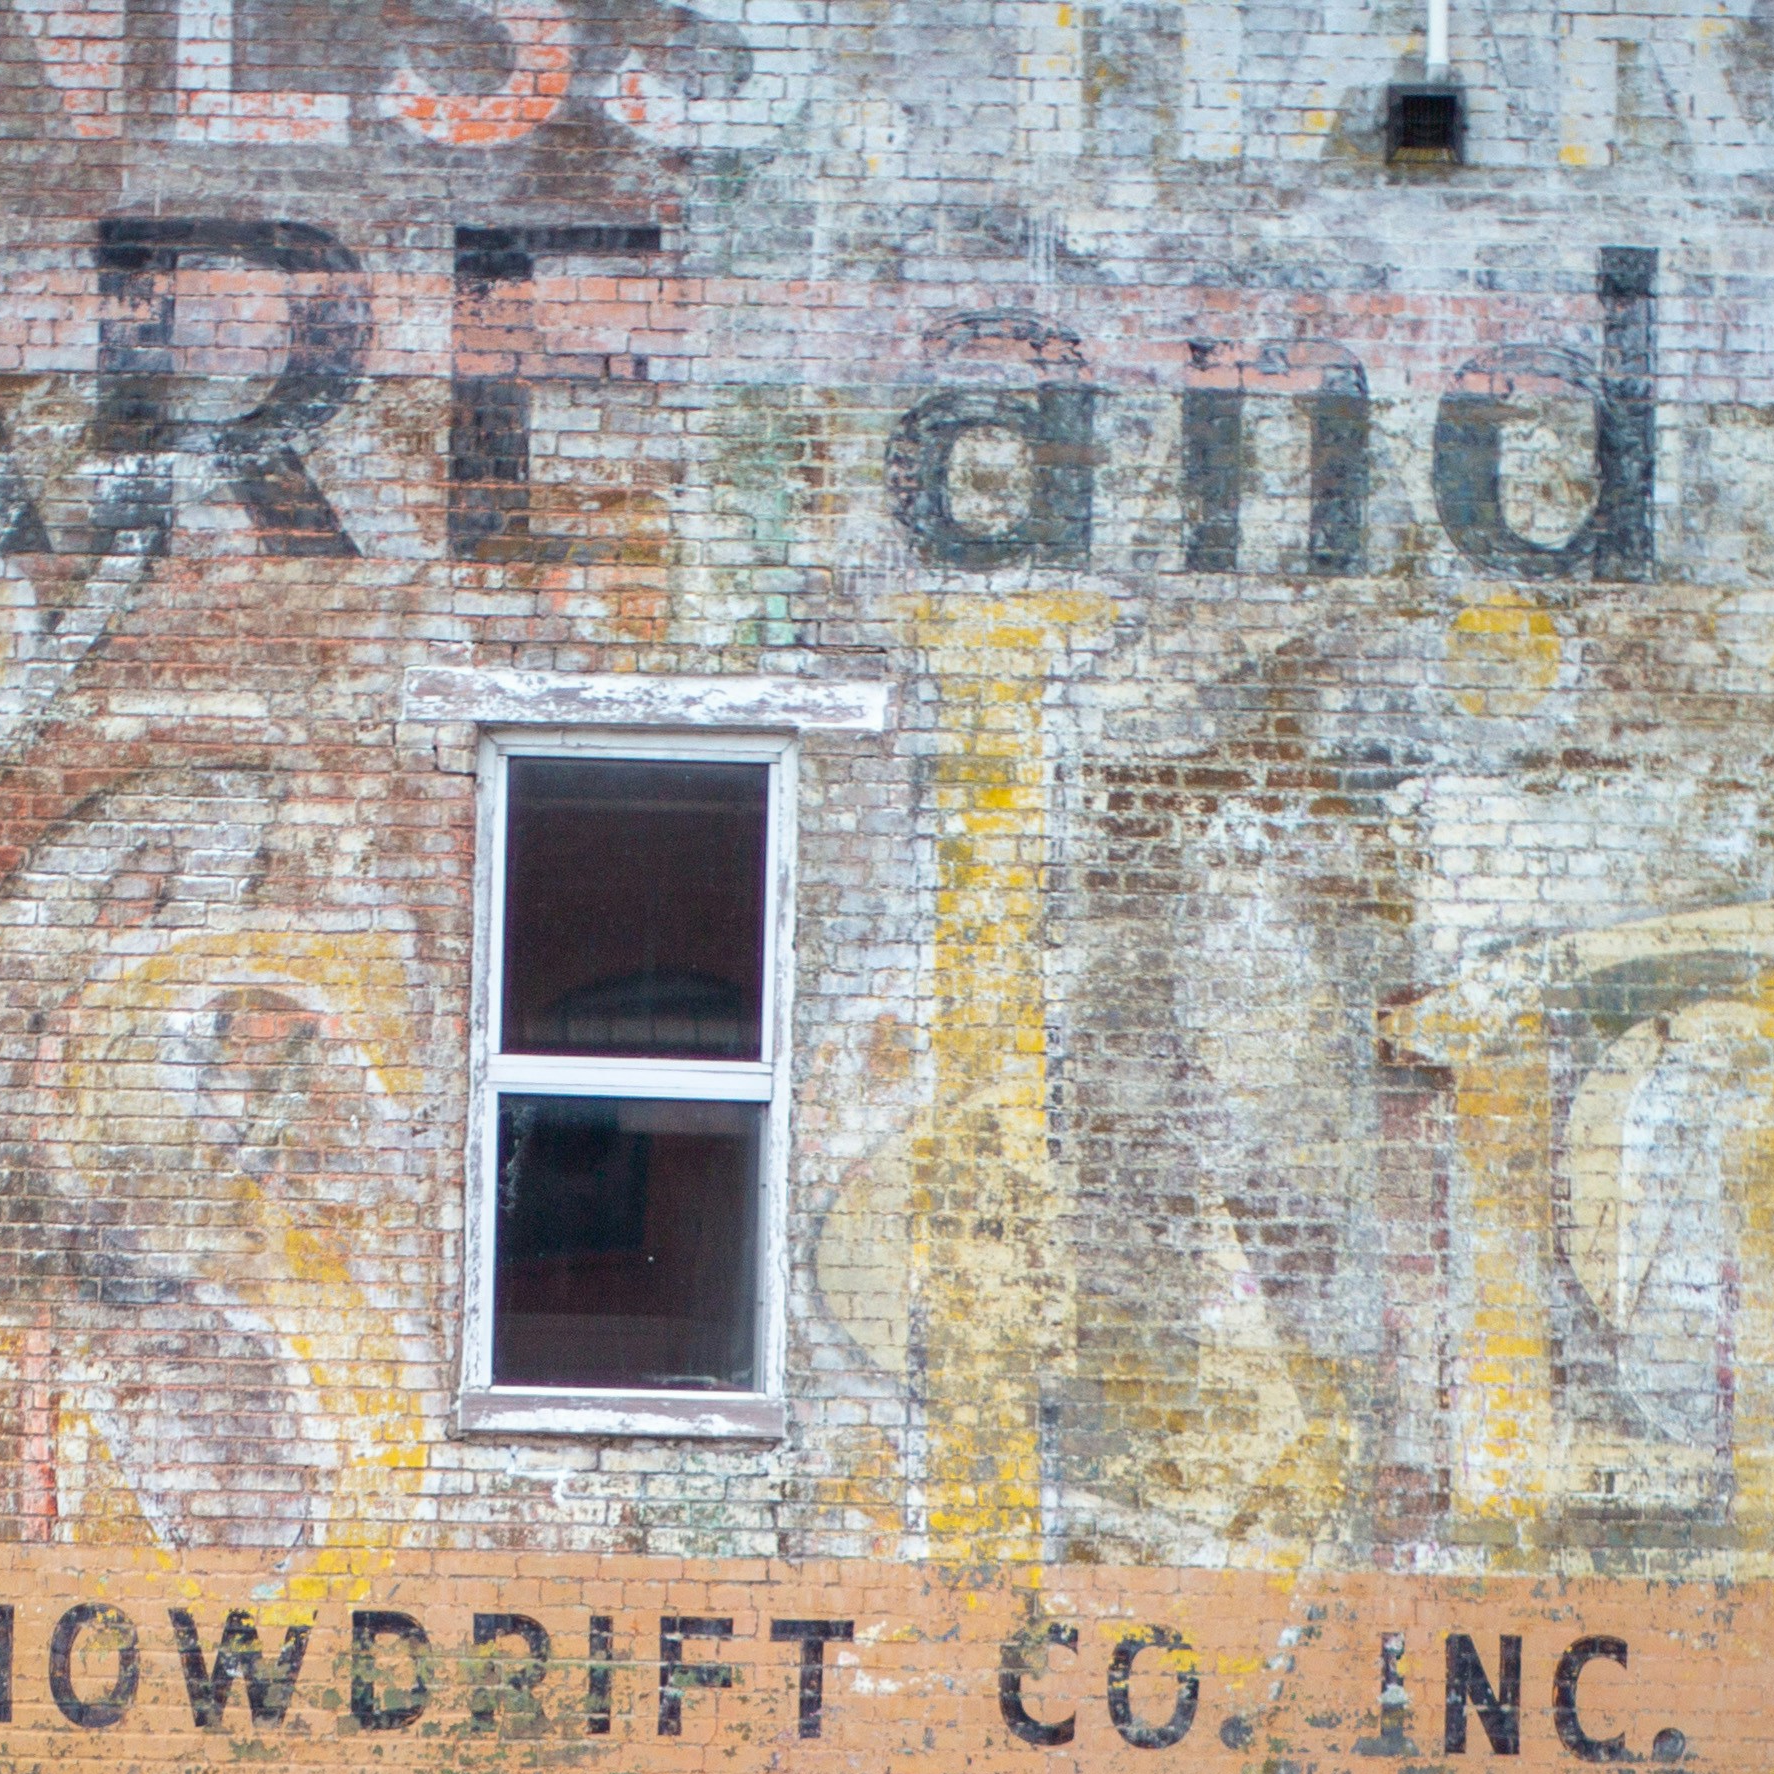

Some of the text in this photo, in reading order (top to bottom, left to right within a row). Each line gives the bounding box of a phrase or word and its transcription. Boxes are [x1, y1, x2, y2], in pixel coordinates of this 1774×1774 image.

[881, 244, 1660, 582] and
[998, 1622, 1253, 1750] CO.
[1366, 1632, 1686, 1766] INC.
